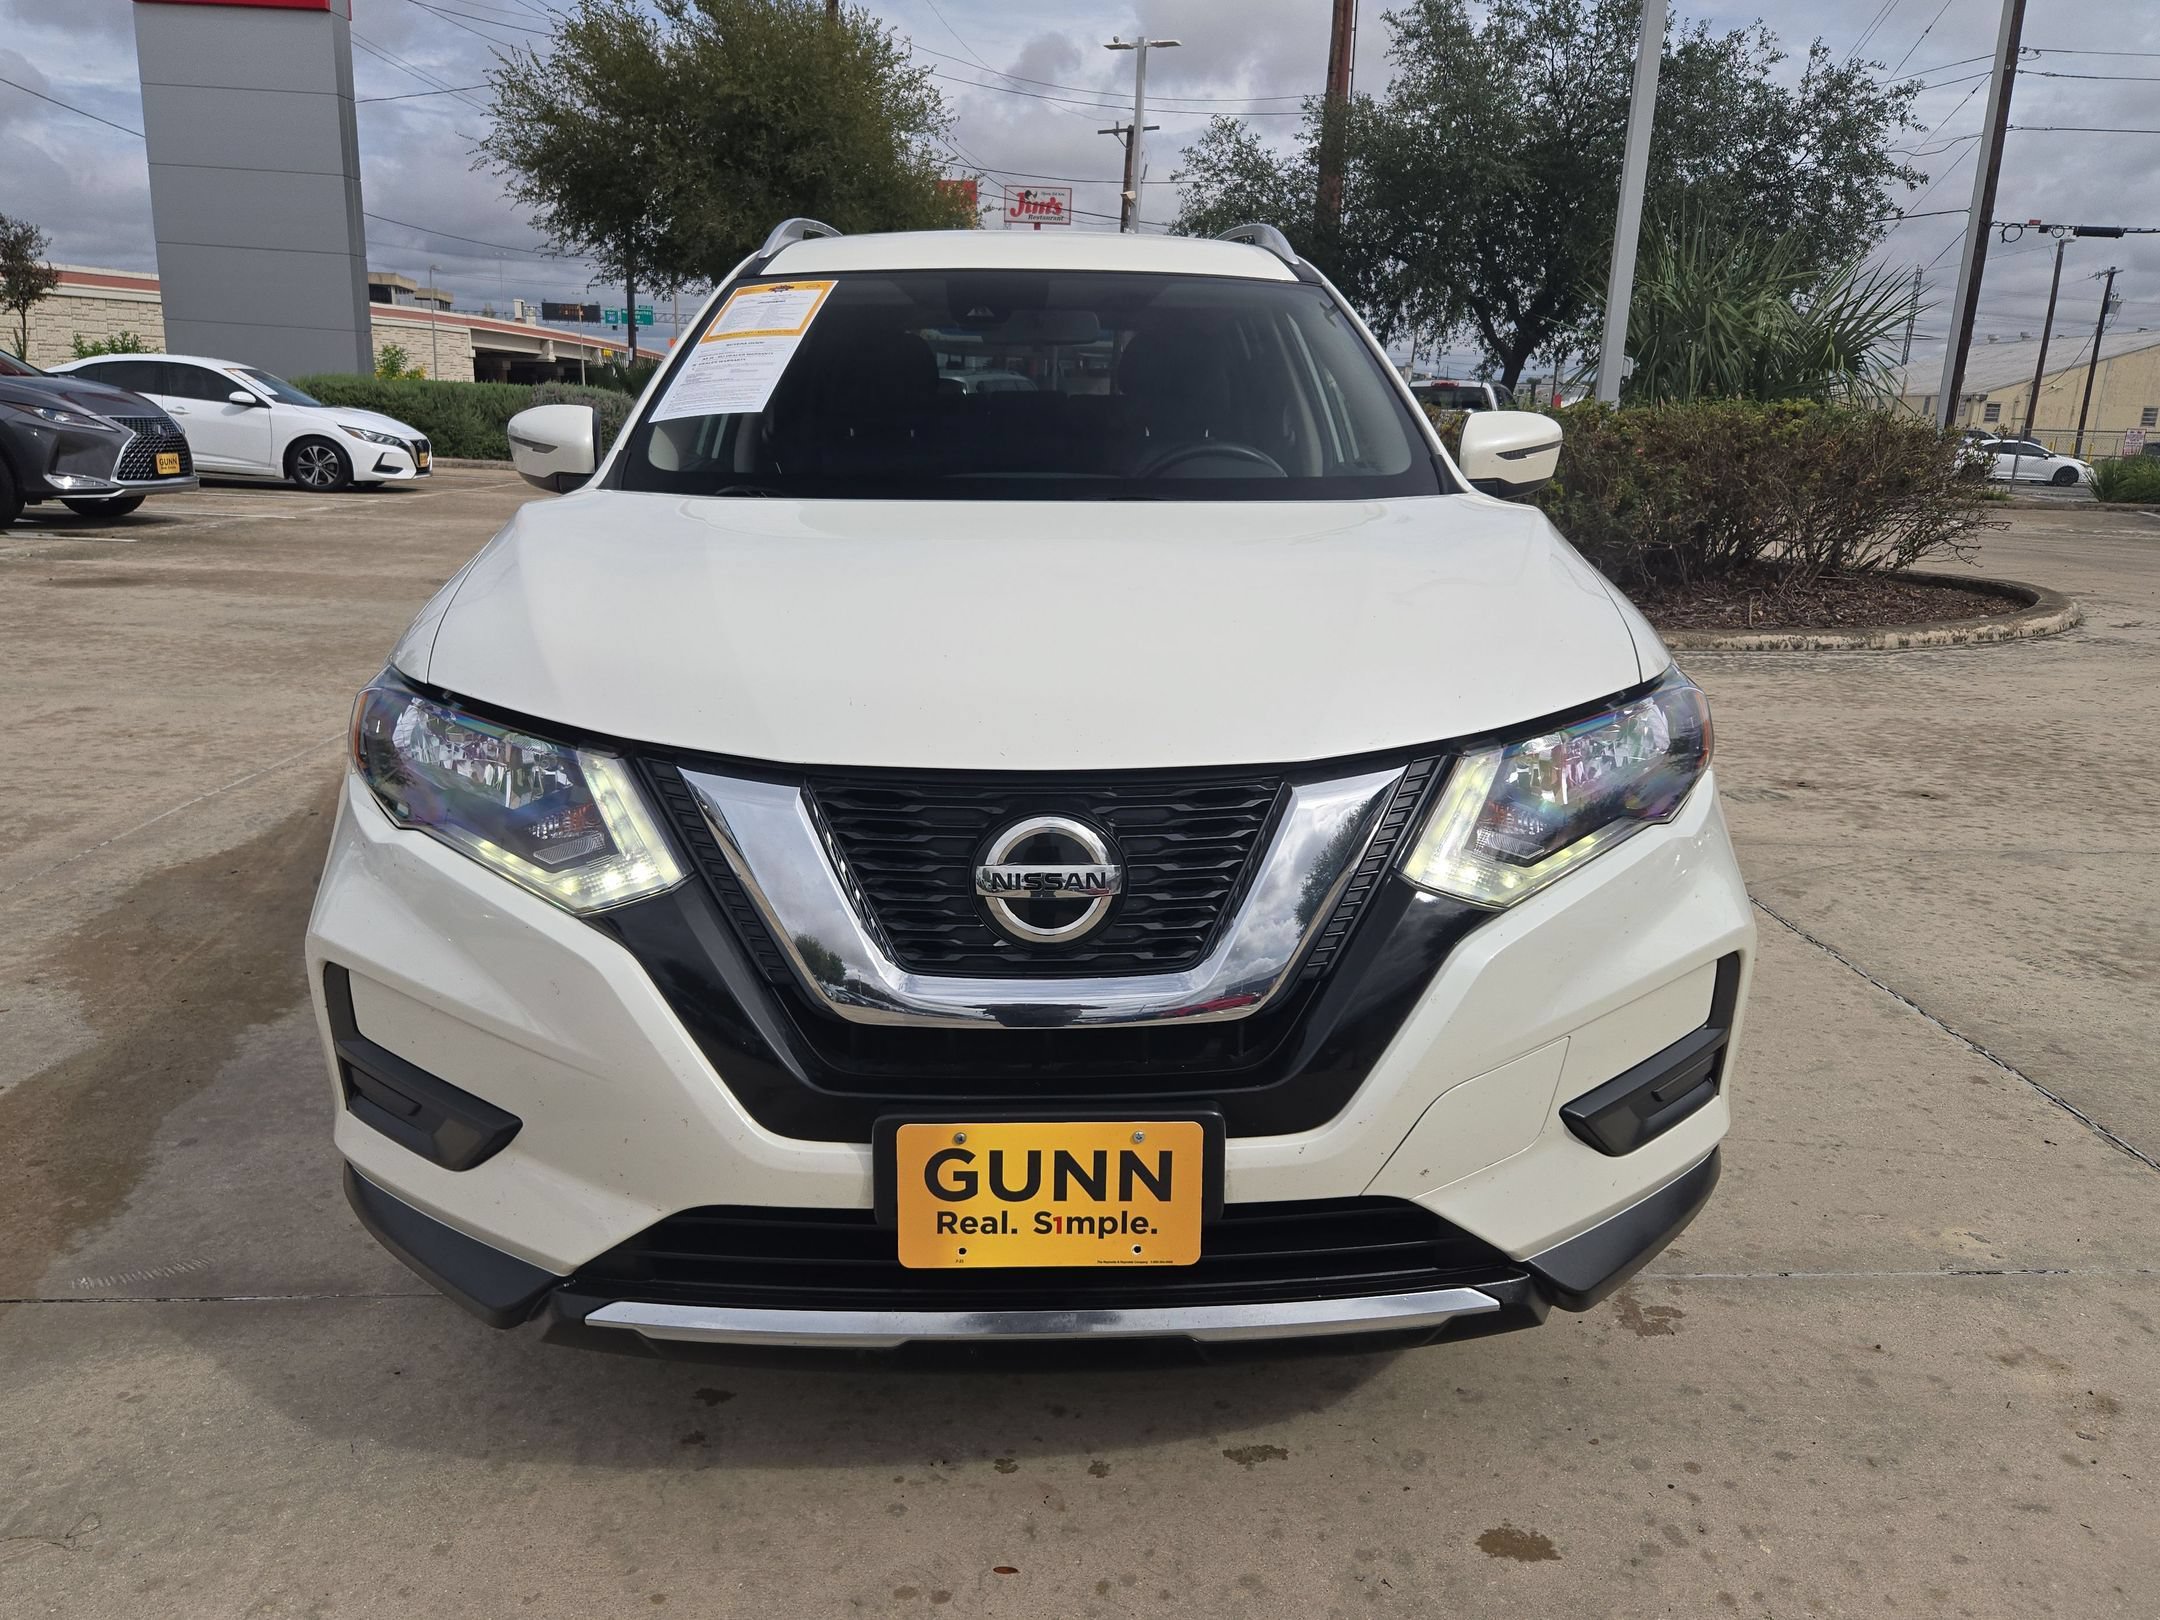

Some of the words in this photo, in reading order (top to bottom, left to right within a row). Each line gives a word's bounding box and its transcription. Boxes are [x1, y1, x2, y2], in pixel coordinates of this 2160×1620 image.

[1028, 214, 1064, 222] Restaurant
[160, 457, 177, 466] GUNN
[992, 872, 1106, 890] NISSAN
[923, 1147, 1173, 1203] GUNN
[936, 1210, 1018, 1235] Real.
